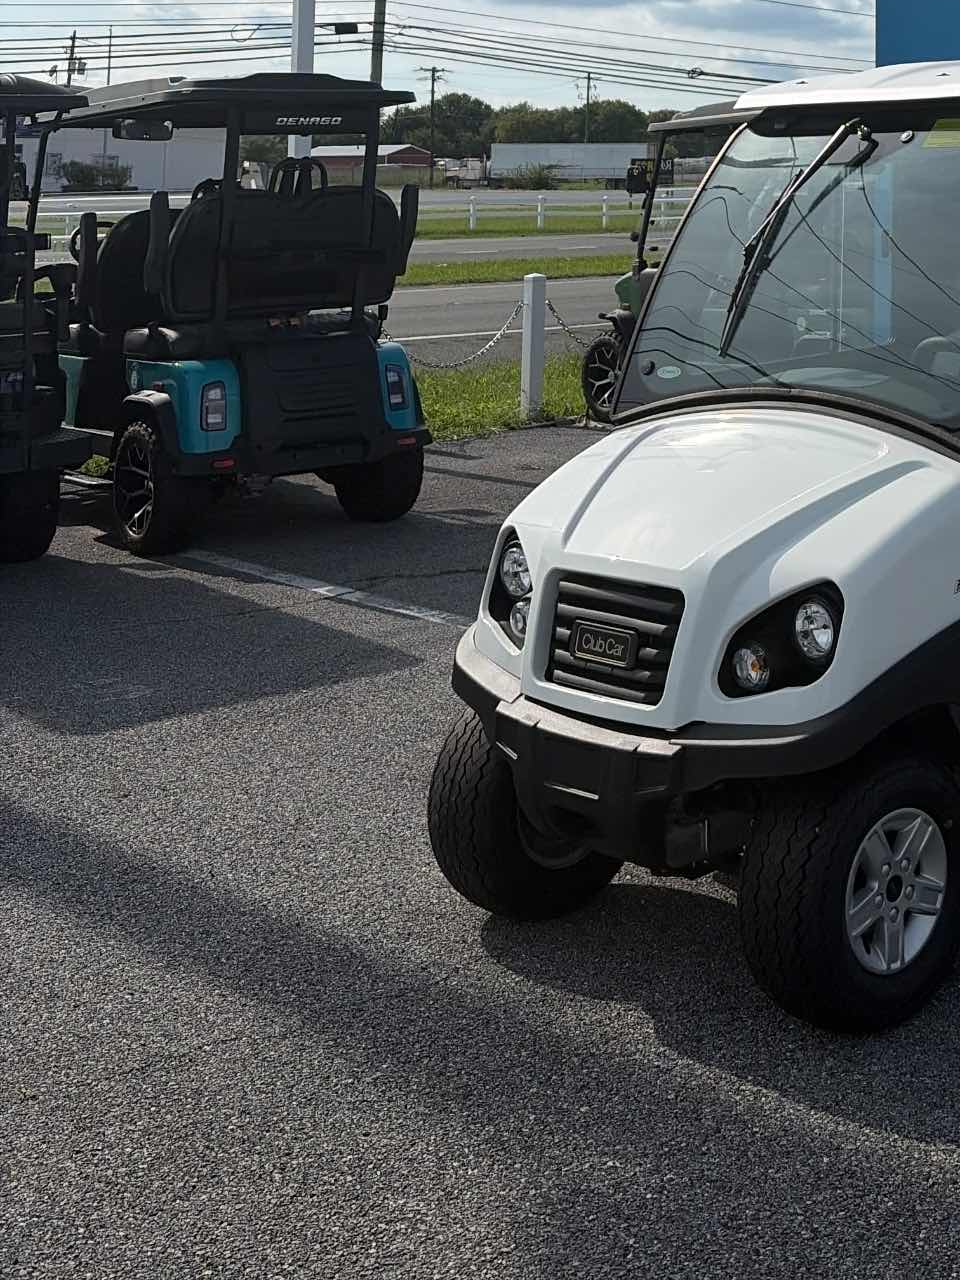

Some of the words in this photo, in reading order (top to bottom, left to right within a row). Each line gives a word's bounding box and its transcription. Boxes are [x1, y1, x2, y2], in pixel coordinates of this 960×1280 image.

[275, 117, 342, 126] DENAGO
[582, 633, 605, 653] Club
[605, 638, 624, 656] Car
